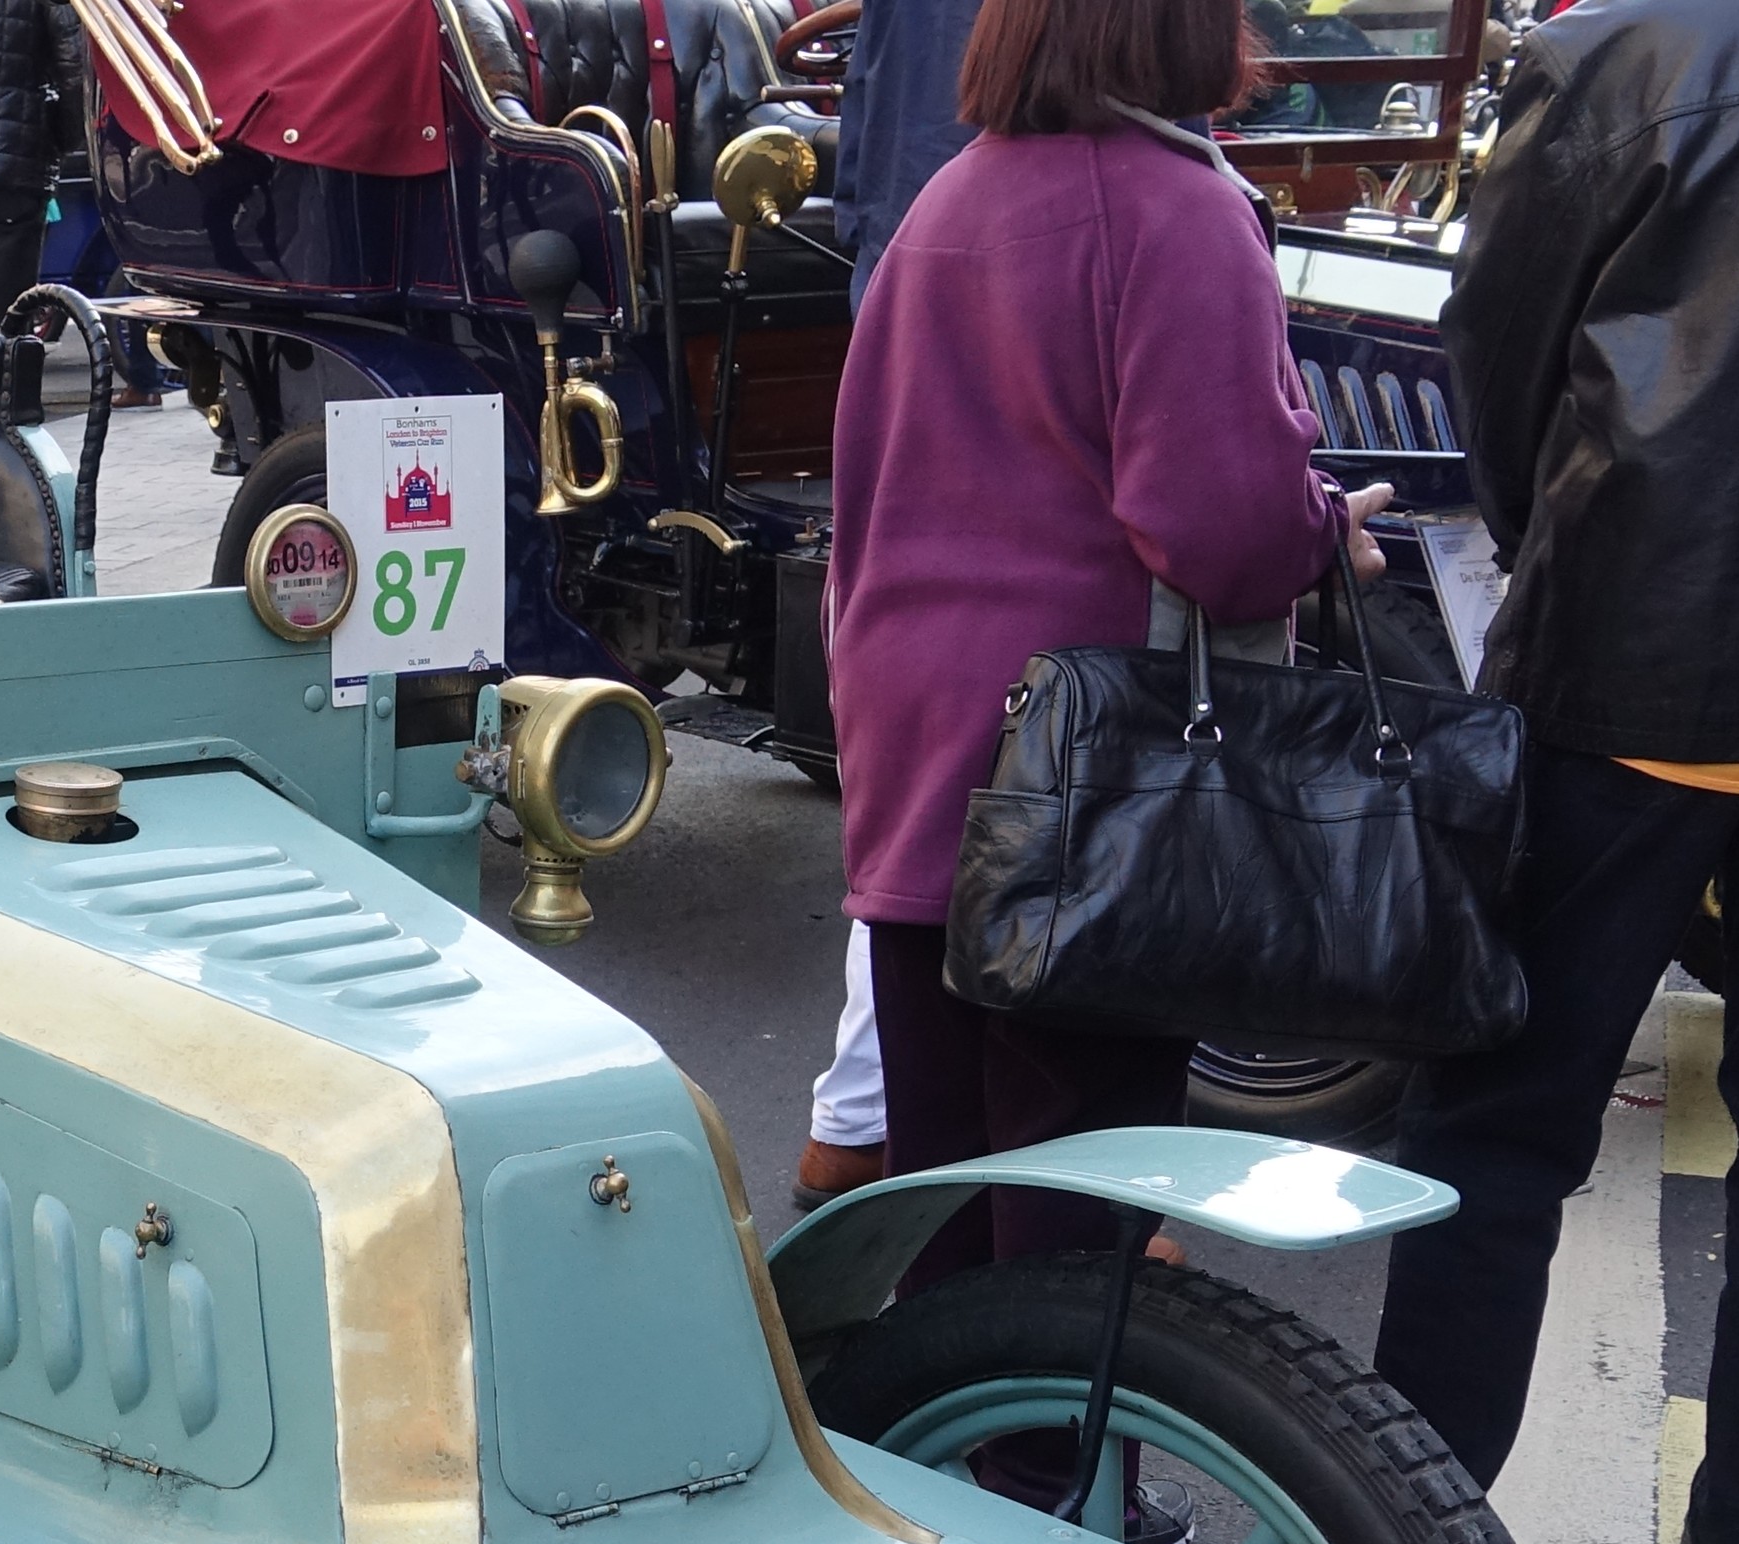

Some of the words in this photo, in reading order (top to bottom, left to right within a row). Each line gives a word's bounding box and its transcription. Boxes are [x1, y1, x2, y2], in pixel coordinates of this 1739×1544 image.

[396, 419, 437, 429] Bonhams
[420, 429, 447, 438] Brighton
[409, 498, 428, 508] 2015
[282, 541, 315, 573] 09
[319, 548, 340, 570] 14
[372, 547, 466, 637] 87
